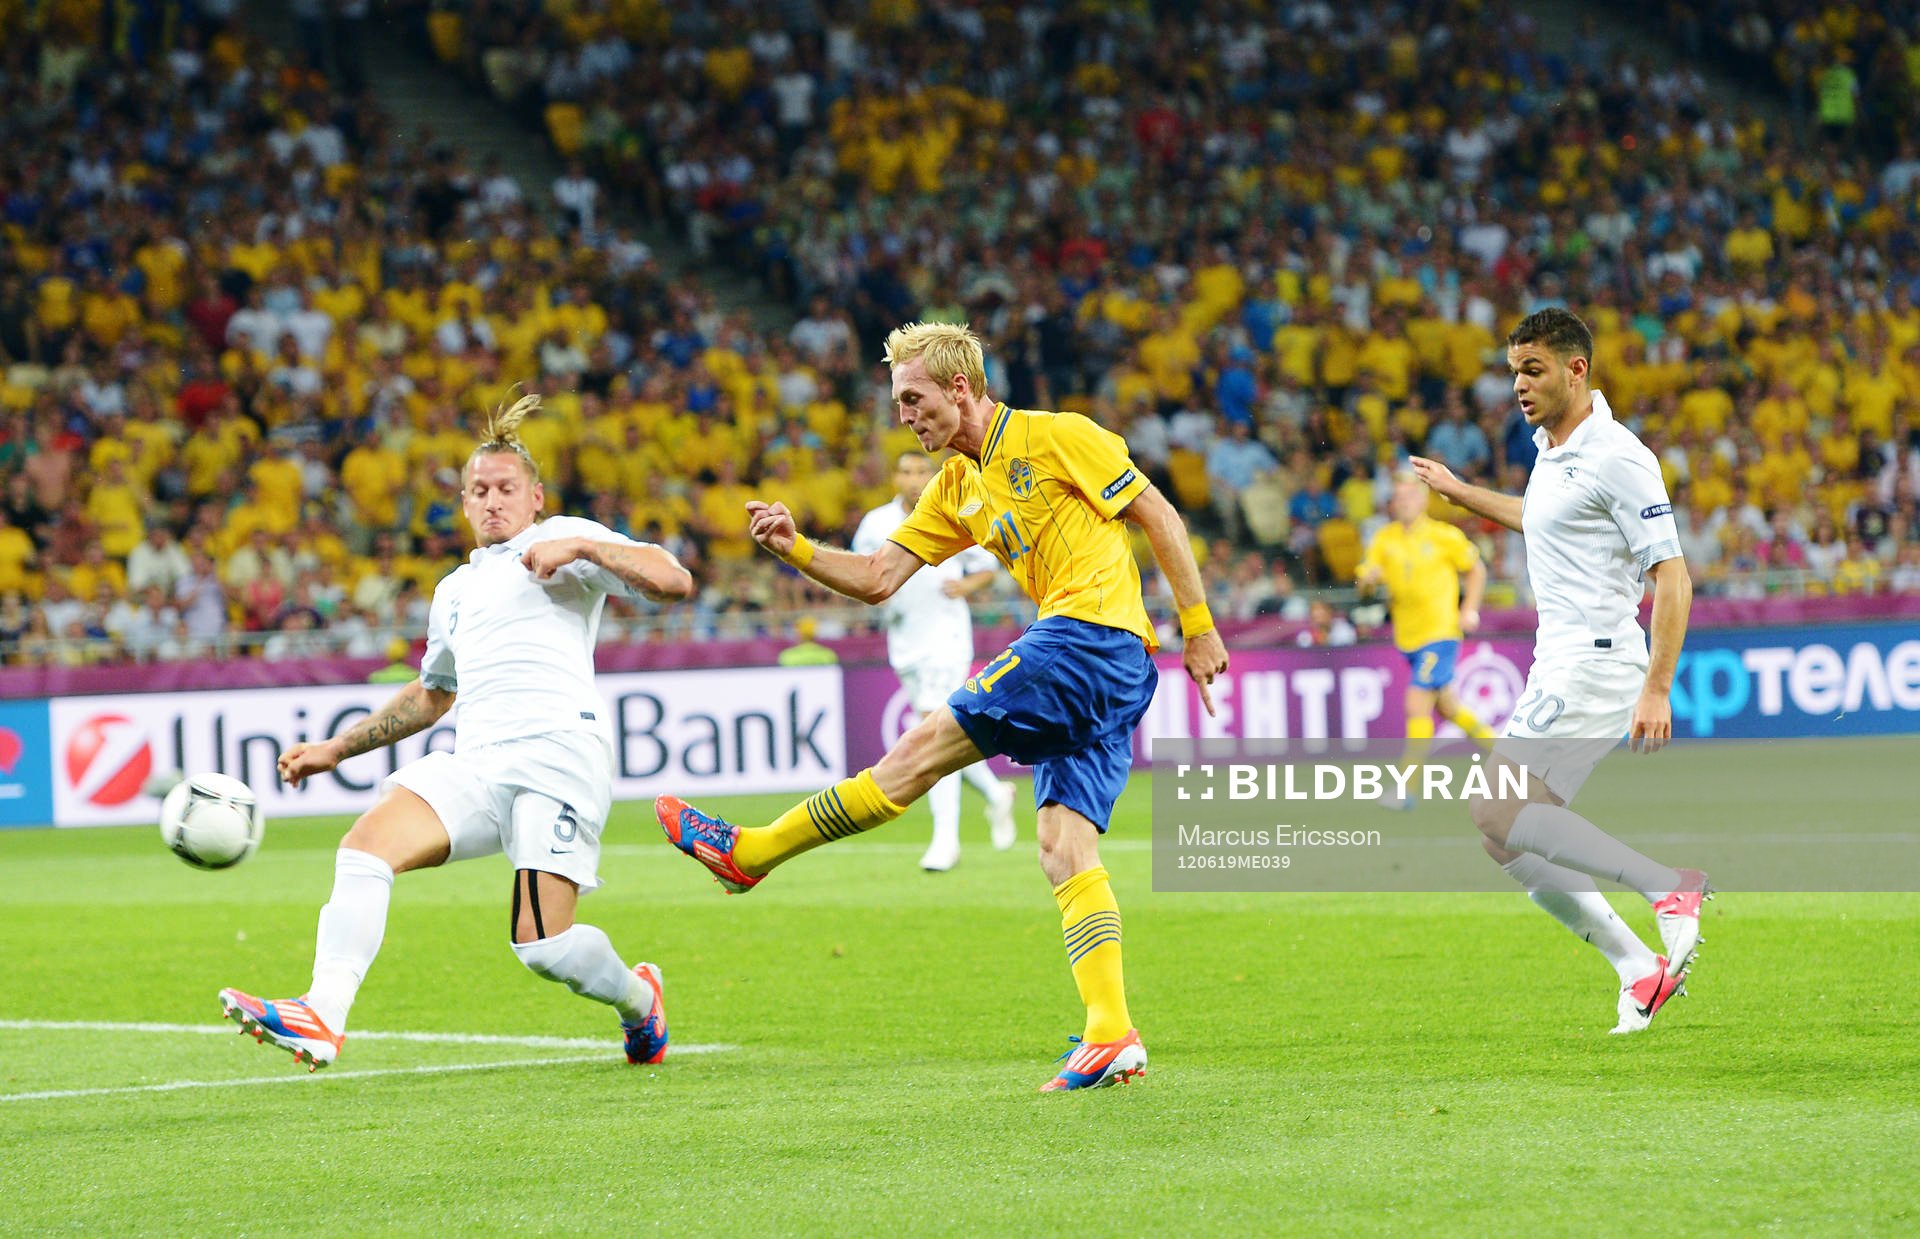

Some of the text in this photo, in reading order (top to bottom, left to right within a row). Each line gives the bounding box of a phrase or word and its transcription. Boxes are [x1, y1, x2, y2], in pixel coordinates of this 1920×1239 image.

[991, 510, 1030, 561] 21
[616, 688, 832, 778] Bank
[1140, 666, 1385, 764] ЦЕНТР
[1669, 641, 1920, 737] кртеле
[554, 803, 577, 843] 5
